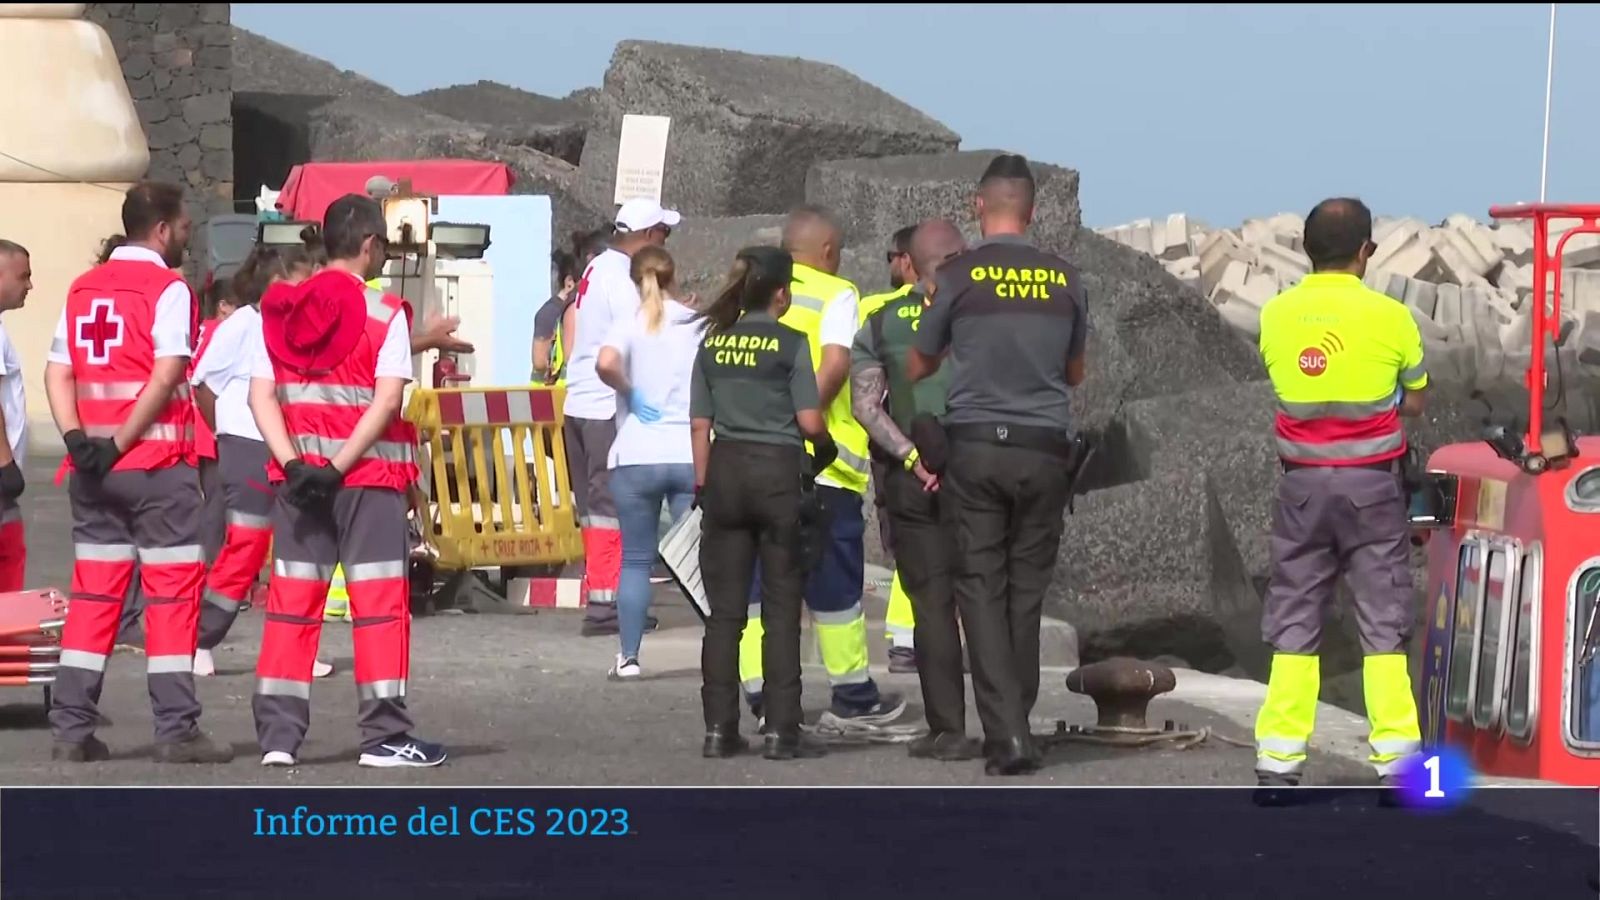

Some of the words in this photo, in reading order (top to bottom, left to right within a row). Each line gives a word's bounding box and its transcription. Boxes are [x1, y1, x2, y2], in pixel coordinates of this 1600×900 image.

[971, 266, 1067, 286] GUARDIA
[995, 284, 1050, 299] CIVIL
[704, 335, 779, 351] GUARDIA
[715, 350, 756, 366] CIVIL
[1300, 355, 1325, 369] SUC
[493, 539, 516, 557] CRUZ
[519, 538, 541, 556] ROJA
